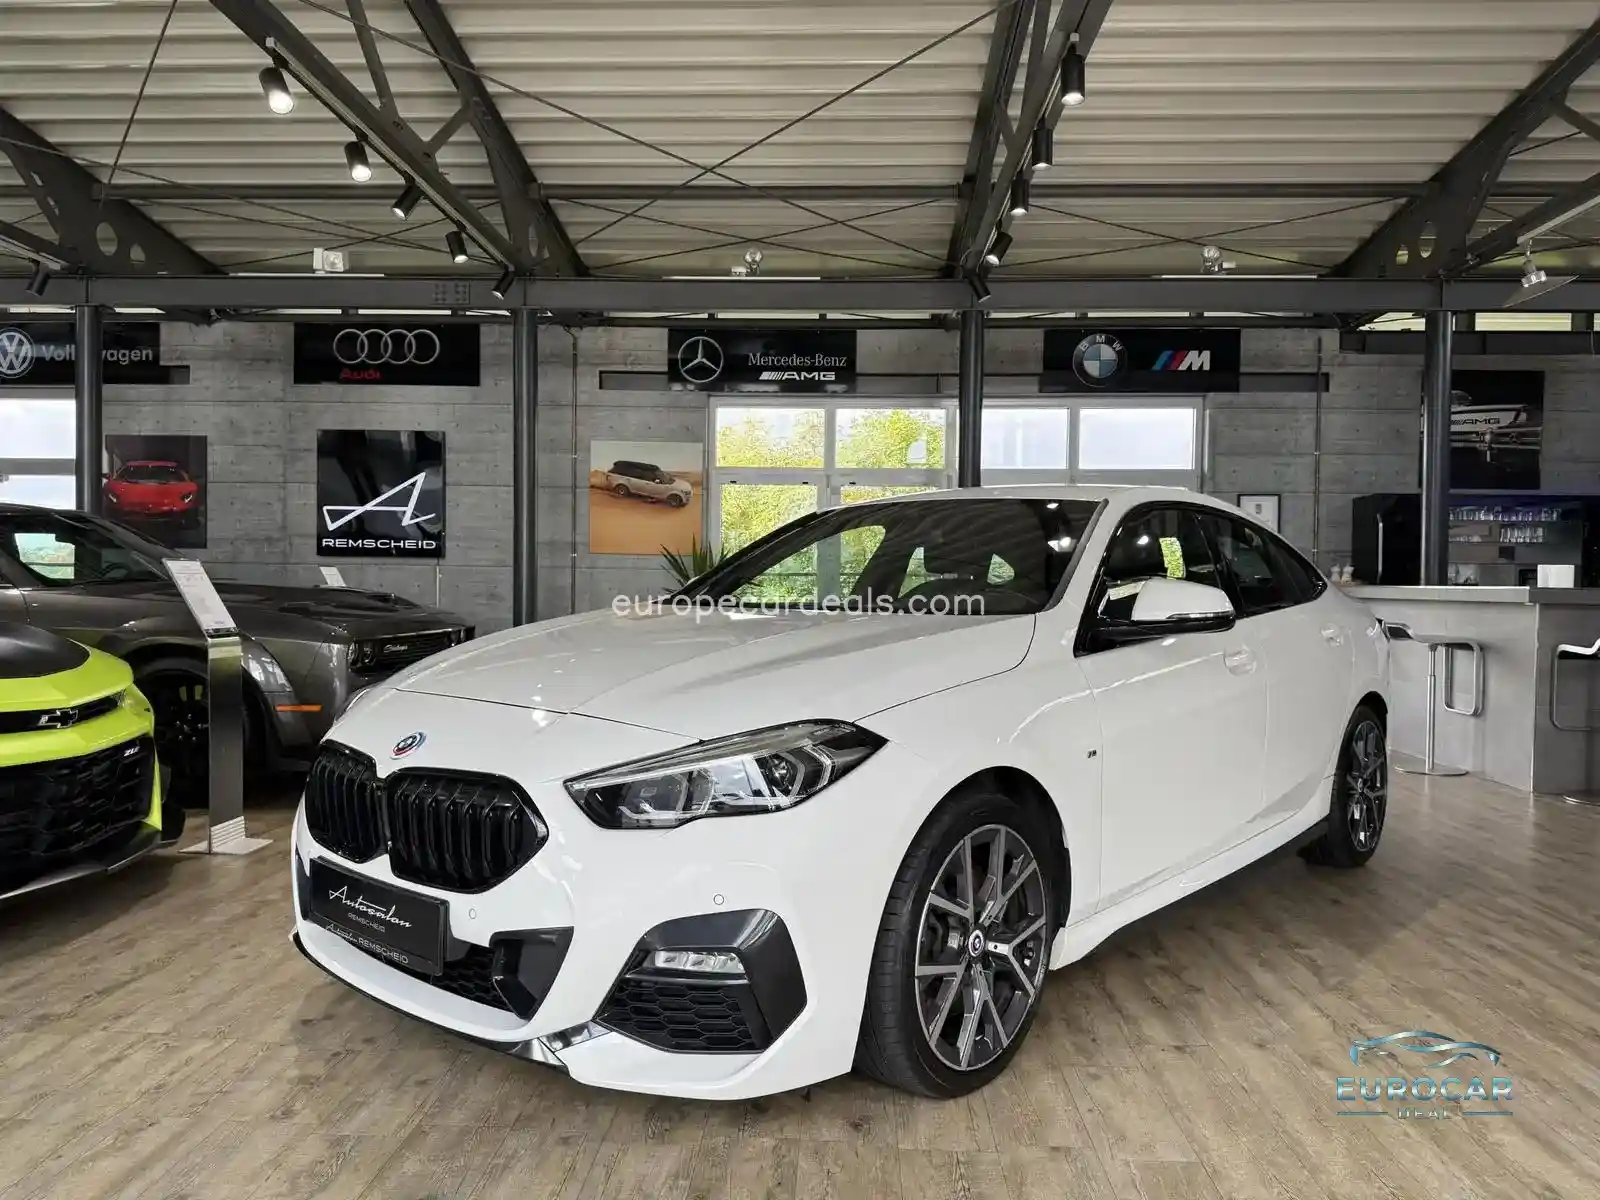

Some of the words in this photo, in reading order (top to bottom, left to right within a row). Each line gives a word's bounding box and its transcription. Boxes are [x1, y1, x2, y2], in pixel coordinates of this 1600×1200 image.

[1080, 335, 1122, 351] BMW
[42, 344, 153, 365] Volagen
[748, 353, 847, 367] Mercedes-Benz
[322, 538, 436, 549] REMSCHEID
[358, 937, 409, 965] REMSCHEID
